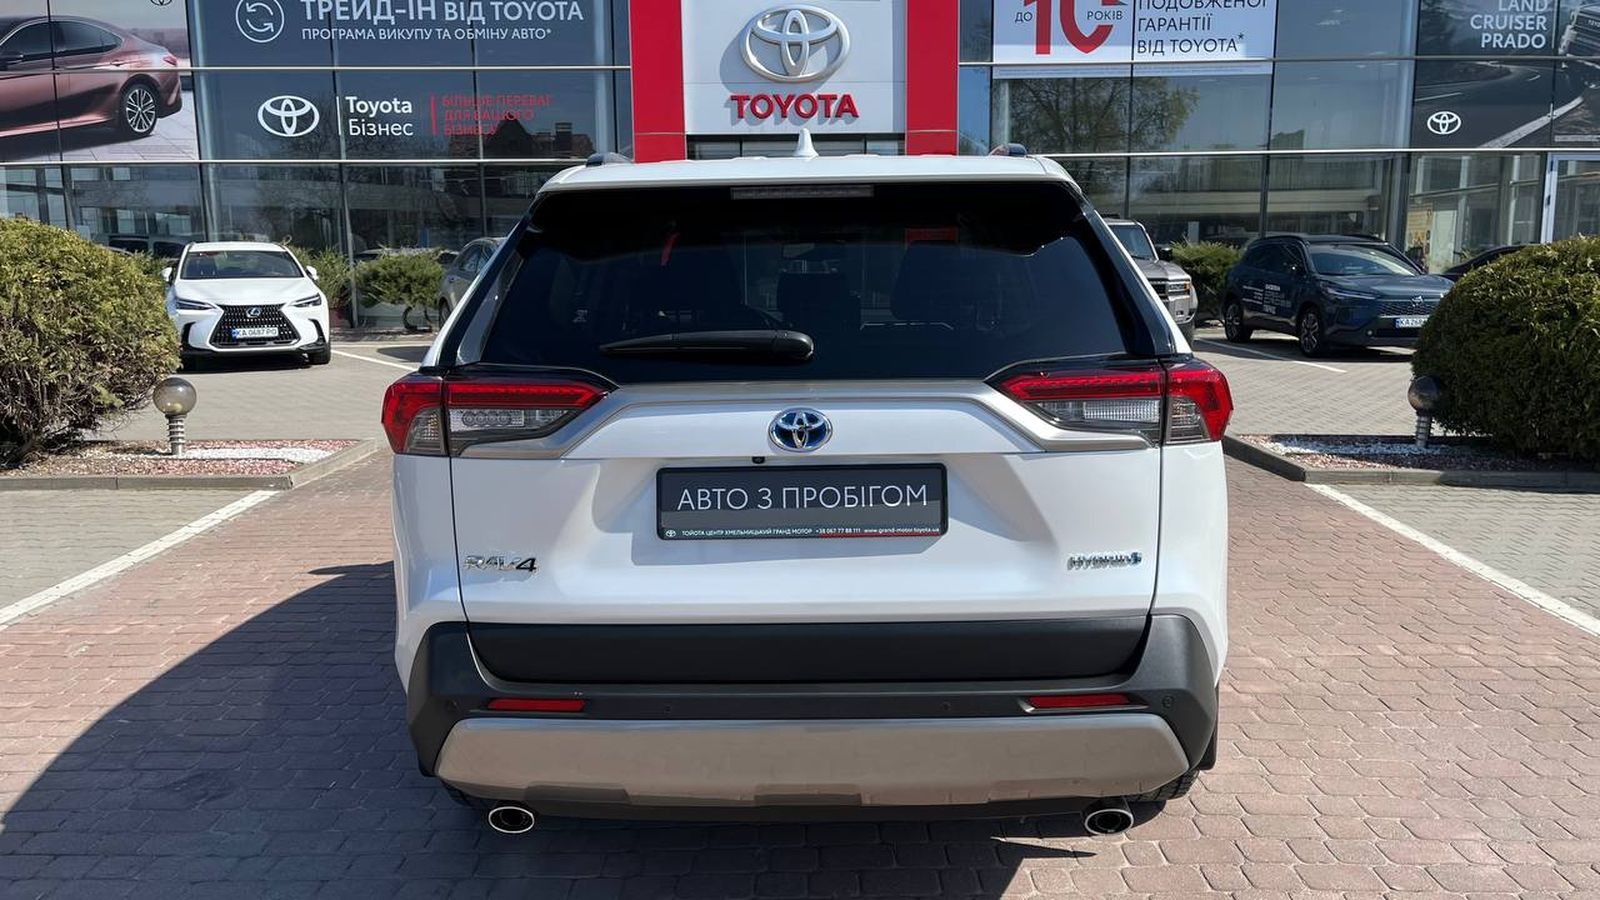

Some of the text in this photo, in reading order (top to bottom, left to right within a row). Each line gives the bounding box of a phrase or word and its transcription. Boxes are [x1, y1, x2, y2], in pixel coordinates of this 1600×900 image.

[444, 1, 485, 25] ВІД
[490, 1, 584, 21] TOYOTA
[1498, 0, 1548, 12] LAND
[1015, 12, 1033, 23] ДО
[1087, 10, 1124, 21] РОКІВ
[1138, 13, 1213, 32] ГАРАНТІЇ
[1470, 14, 1547, 30] CRUISER
[302, 28, 376, 40] ПРОГРАМА
[379, 28, 432, 40] ВИКУПУ
[436, 28, 452, 40] ТА
[454, 28, 508, 40] ОБМІНУ
[1481, 33, 1546, 48] PRADO
[1137, 39, 1164, 56] ВІД
[345, 96, 413, 118] Toyota
[730, 93, 860, 119] TOYOTA
[348, 118, 414, 136] Бізнес
[677, 484, 927, 510] АВТО З ПРОБІГОМ
